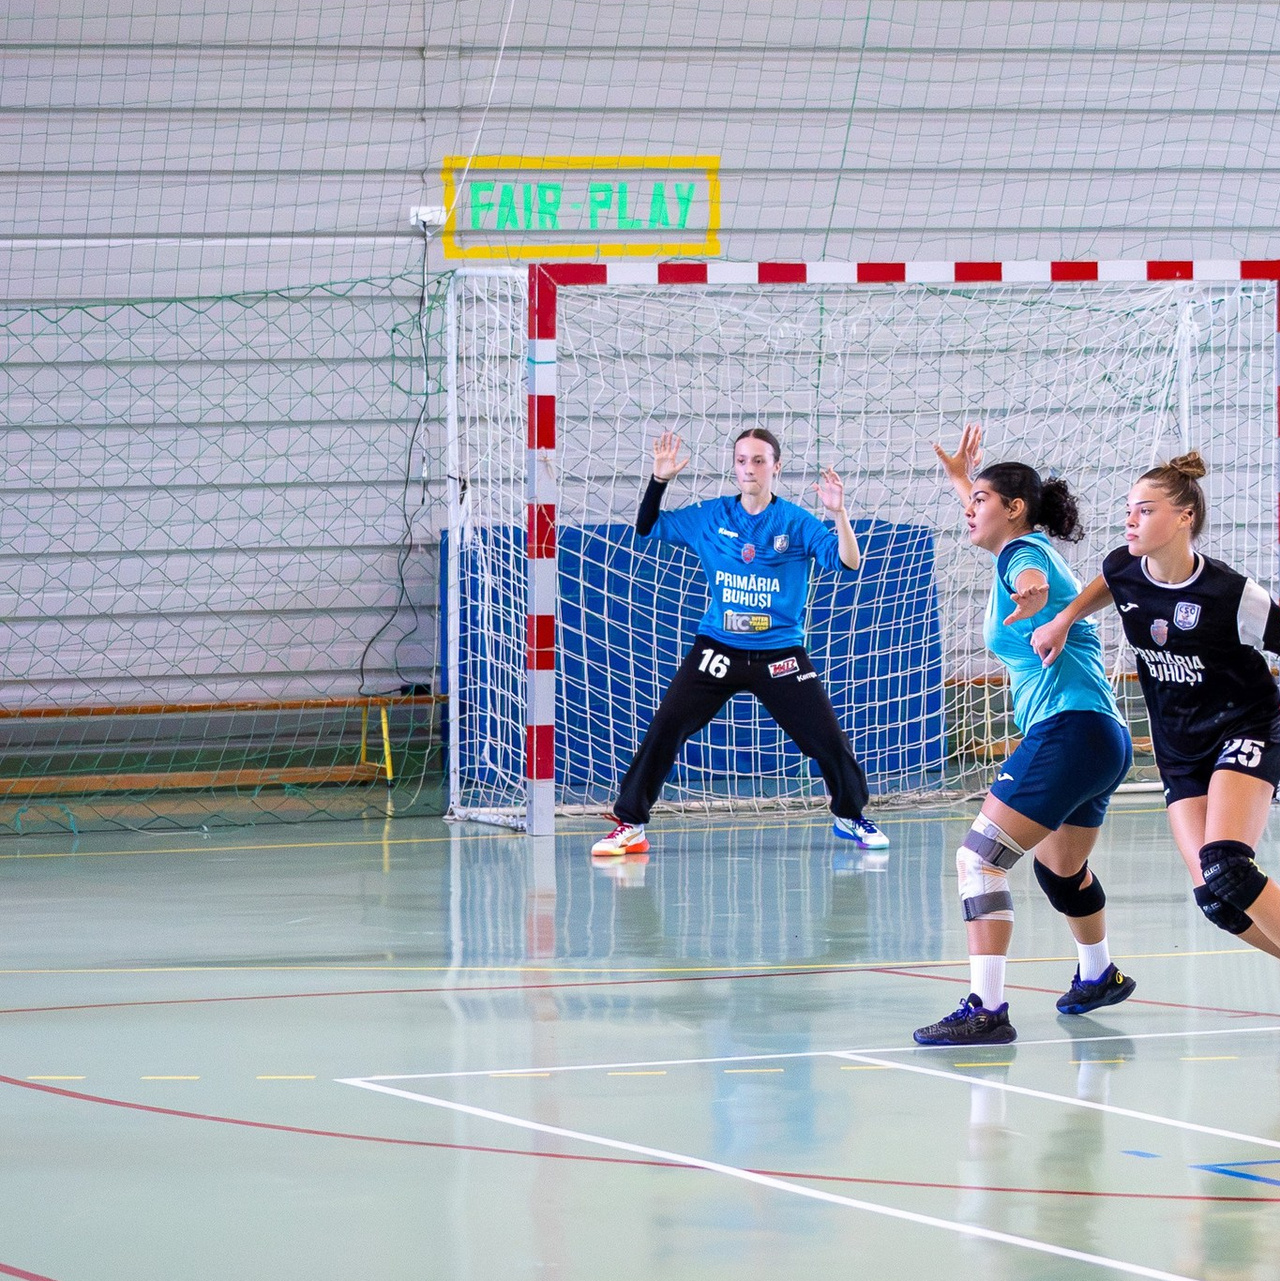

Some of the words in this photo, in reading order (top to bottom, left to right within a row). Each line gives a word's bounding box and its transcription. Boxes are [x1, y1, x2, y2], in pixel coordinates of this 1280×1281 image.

[715, 570, 780, 592] PRIMĂRIA
[698, 648, 731, 679] 16
[1215, 738, 1265, 768] 25
